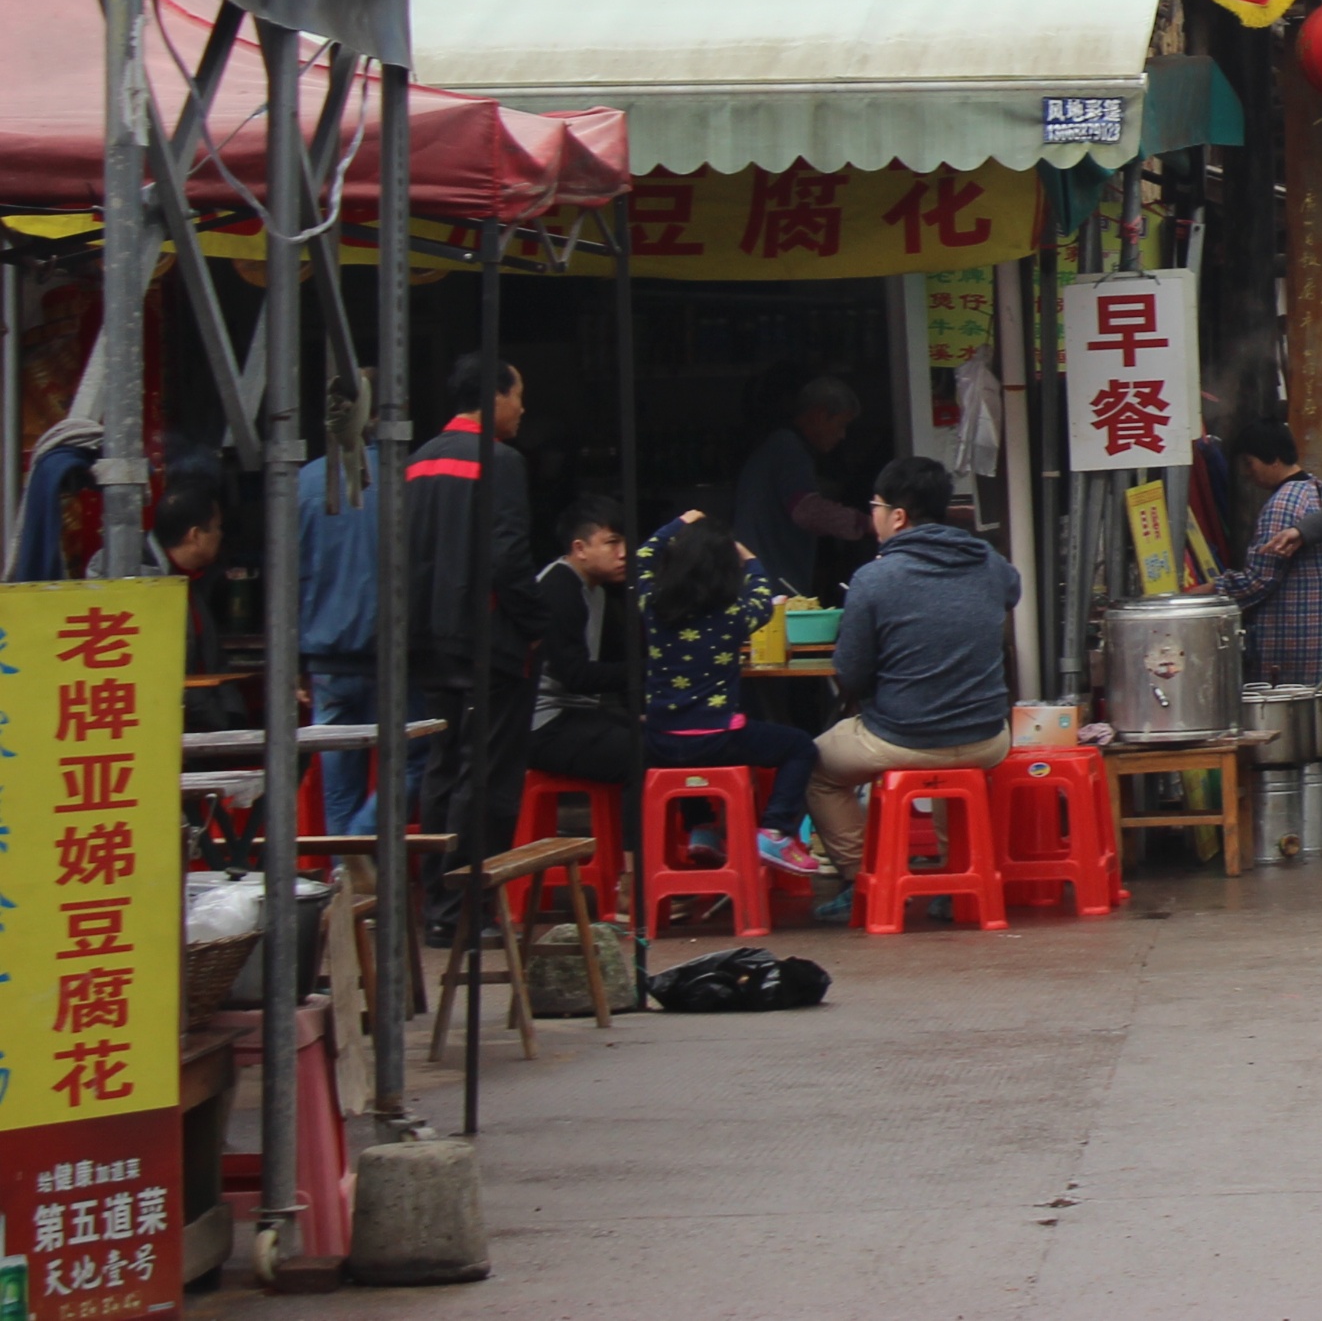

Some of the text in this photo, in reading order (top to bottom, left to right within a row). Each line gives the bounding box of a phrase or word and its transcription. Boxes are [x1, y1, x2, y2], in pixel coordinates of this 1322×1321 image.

[1086, 293, 1171, 457] 早餐
[51, 606, 140, 1109] 老牌亚娣豆腐花
[33, 1186, 168, 1253] 第五道菜
[43, 1243, 158, 1297] 天地壹号
